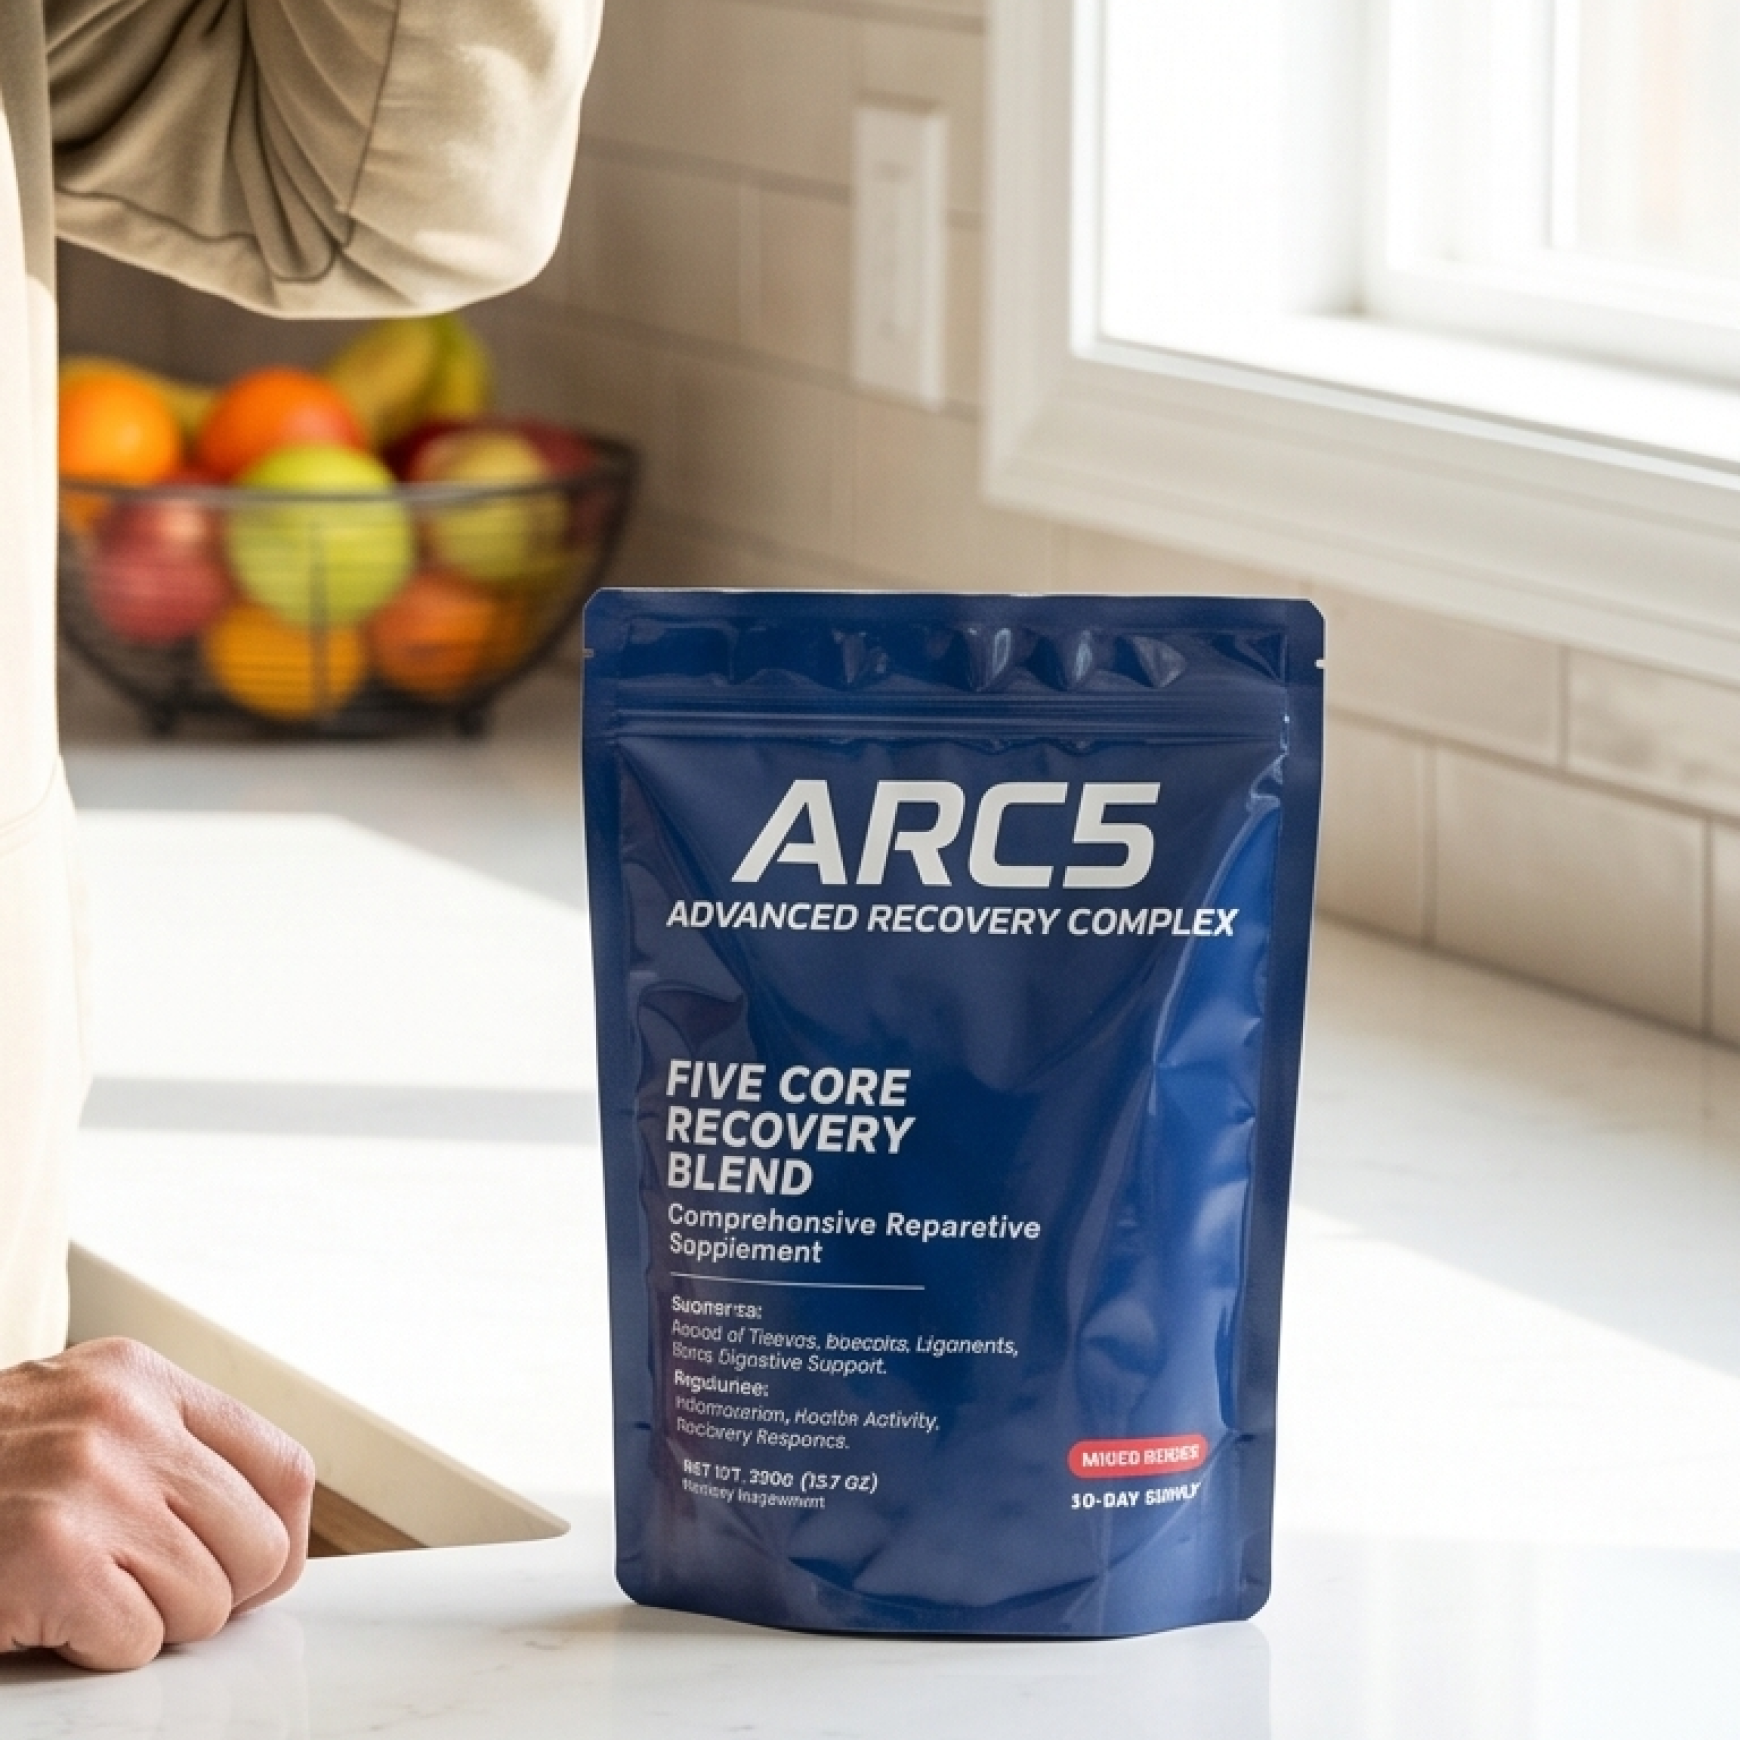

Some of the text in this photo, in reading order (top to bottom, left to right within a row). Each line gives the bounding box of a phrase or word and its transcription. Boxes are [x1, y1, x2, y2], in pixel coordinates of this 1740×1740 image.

[731, 779, 1162, 889] ARC5
[666, 900, 1239, 938] ADVANCED RECOVERY COMPLEX
[666, 1058, 912, 1107] FIVE CORE
[666, 1106, 916, 1154] RECOVERY
[667, 1151, 813, 1196] BLEND
